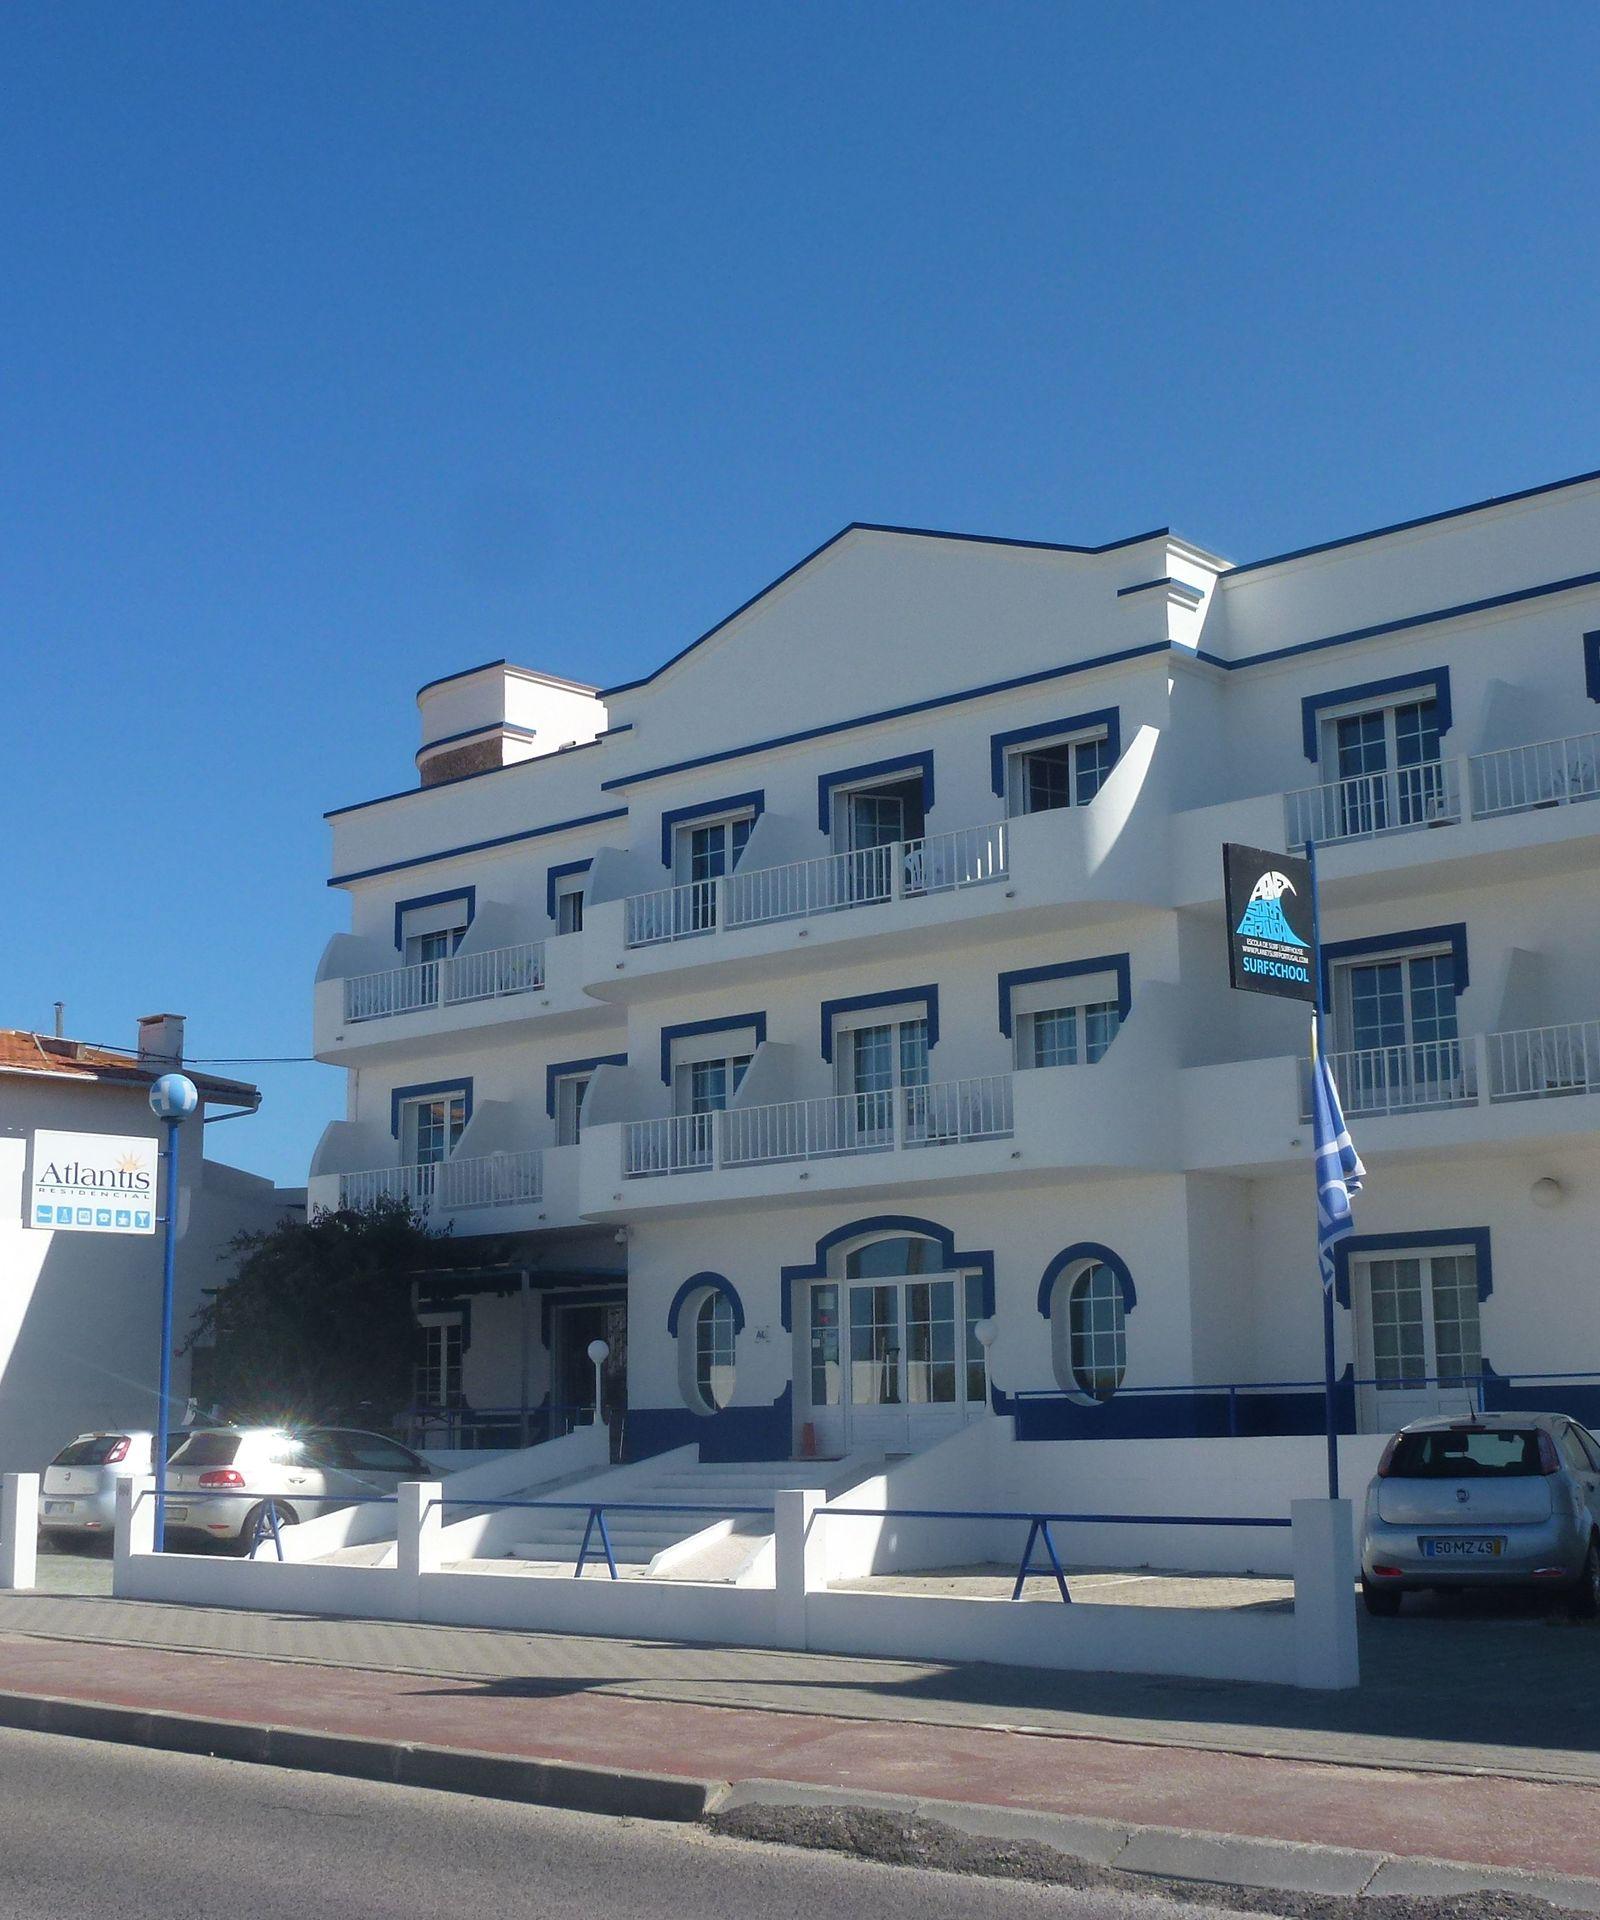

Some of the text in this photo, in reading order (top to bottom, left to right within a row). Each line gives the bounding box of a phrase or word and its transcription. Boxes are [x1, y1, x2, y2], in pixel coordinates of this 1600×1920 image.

[1243, 956, 1310, 983] SURFSCHOOL
[40, 1162, 151, 1190] Atlantis
[38, 1187, 150, 1200] RESIDENCIAL
[1435, 1541, 1451, 1554] 50
[1453, 1541, 1475, 1554] MZ
